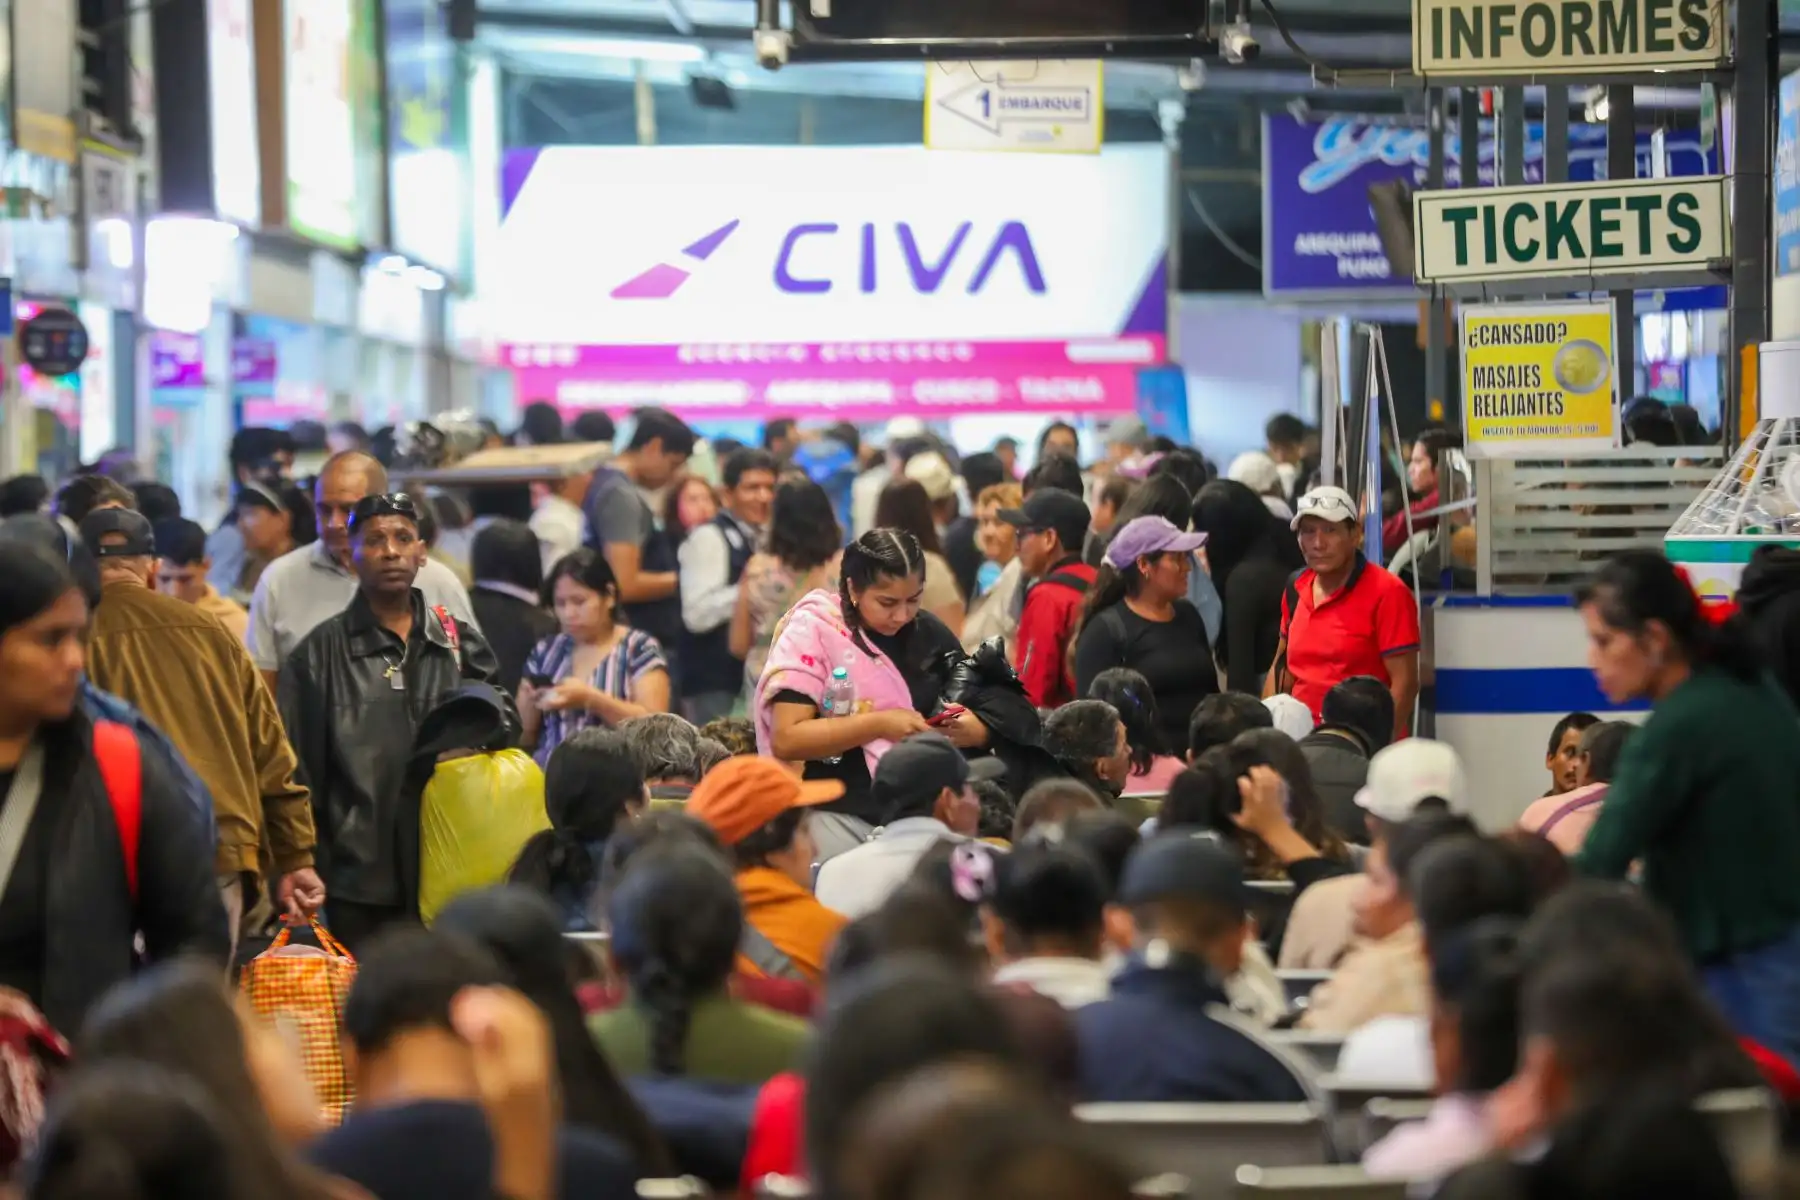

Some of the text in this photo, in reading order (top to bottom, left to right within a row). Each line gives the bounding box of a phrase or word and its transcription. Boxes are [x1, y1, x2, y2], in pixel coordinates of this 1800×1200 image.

[1431, 0, 1711, 59] INFORMES
[976, 89, 1083, 119] 1 EMBARQUE
[1442, 192, 1702, 266] TICKETS
[773, 220, 1048, 294] CIVA
[1469, 321, 1567, 348] ¿CANSADO?
[1473, 364, 1541, 389] MASAJES
[1473, 392, 1564, 418] RELAJANTES
